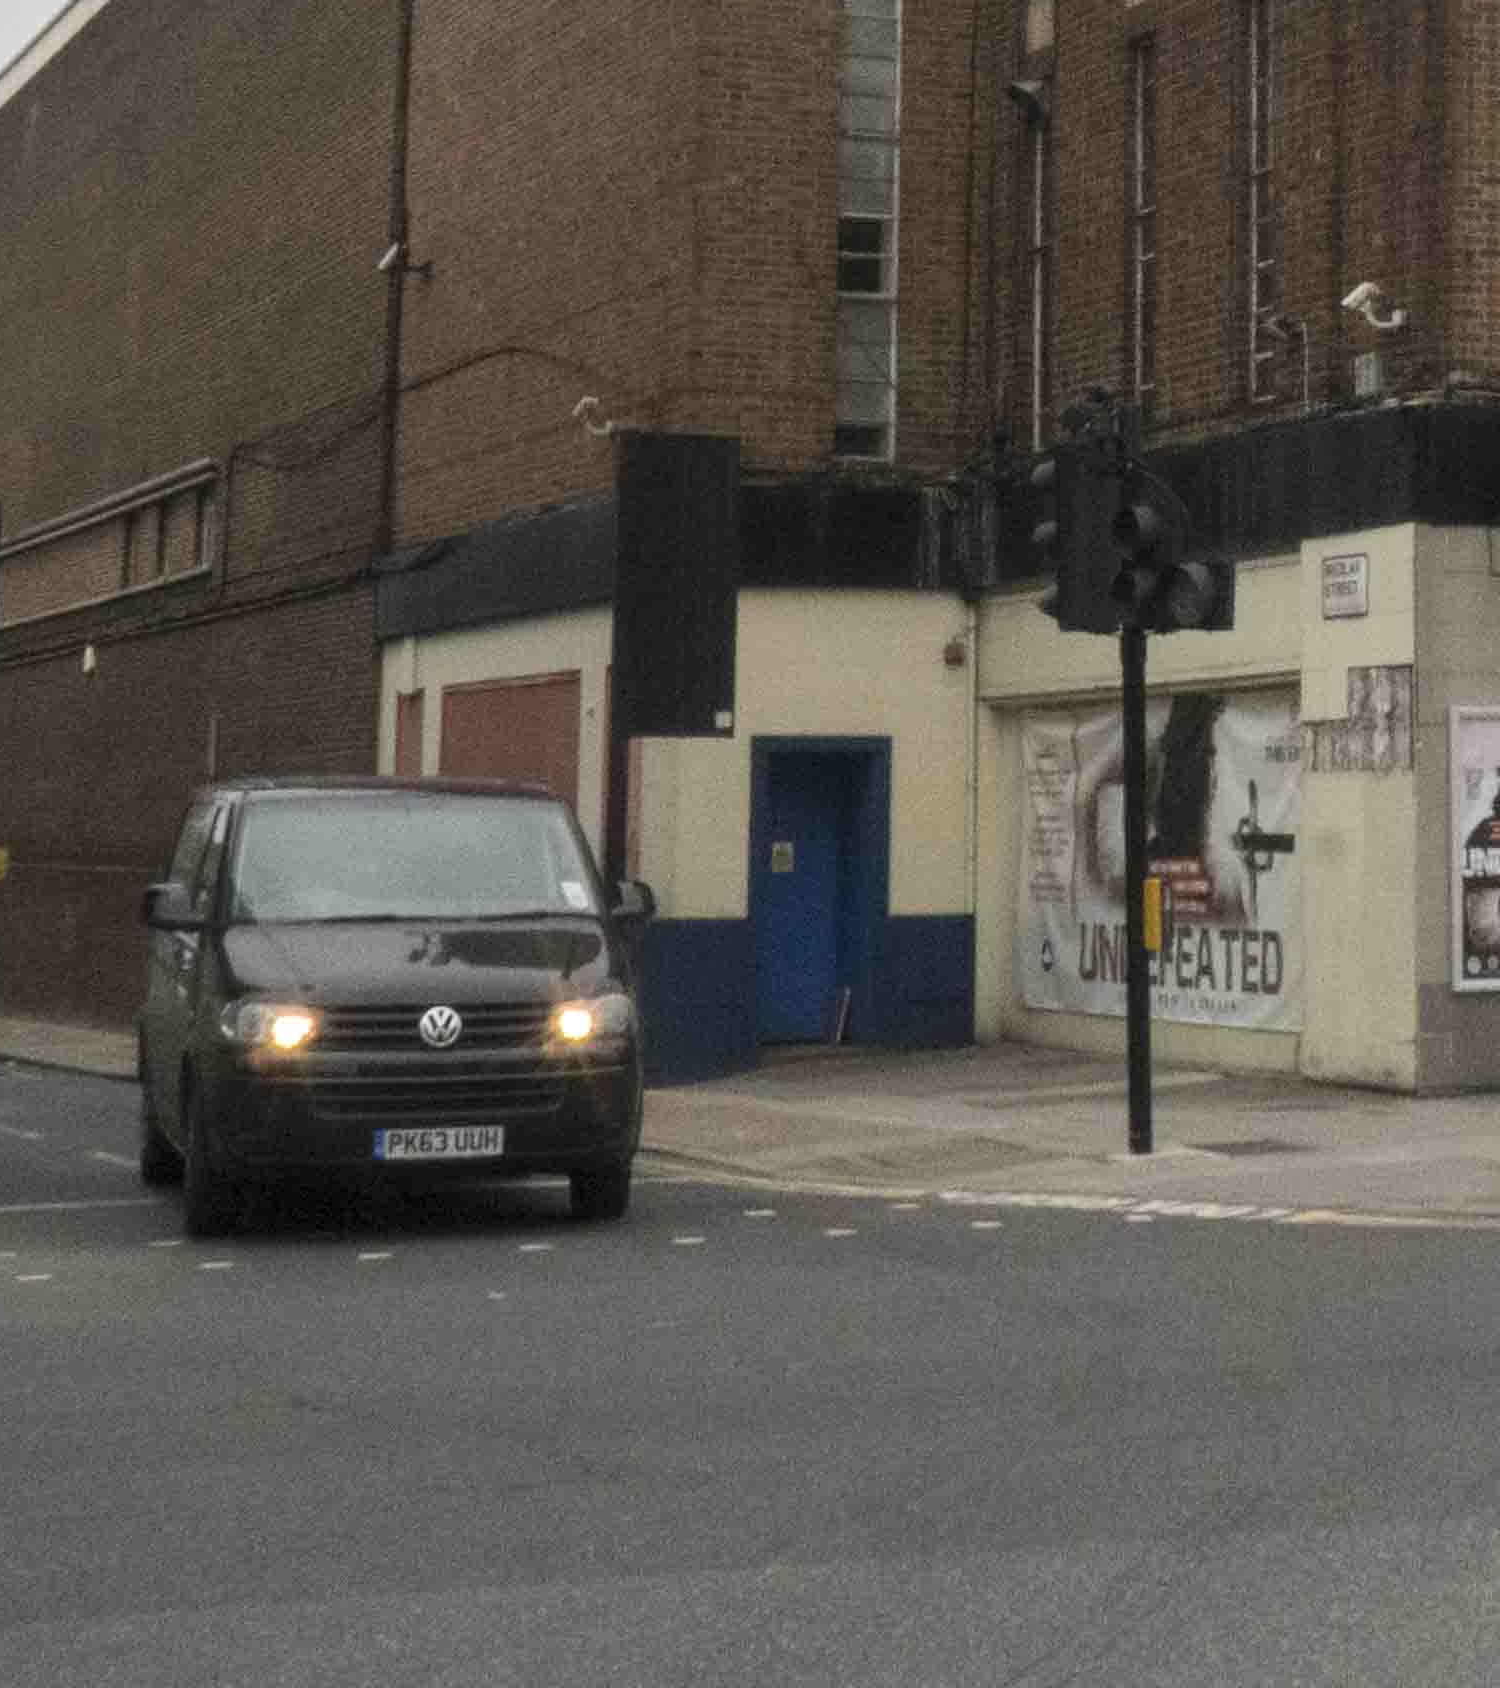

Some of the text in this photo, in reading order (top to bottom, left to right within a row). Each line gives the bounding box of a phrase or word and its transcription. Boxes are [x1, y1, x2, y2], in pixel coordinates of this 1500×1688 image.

[1077, 920, 1285, 995] UNFEATED
[389, 1129, 499, 1154] PK63 UUH
